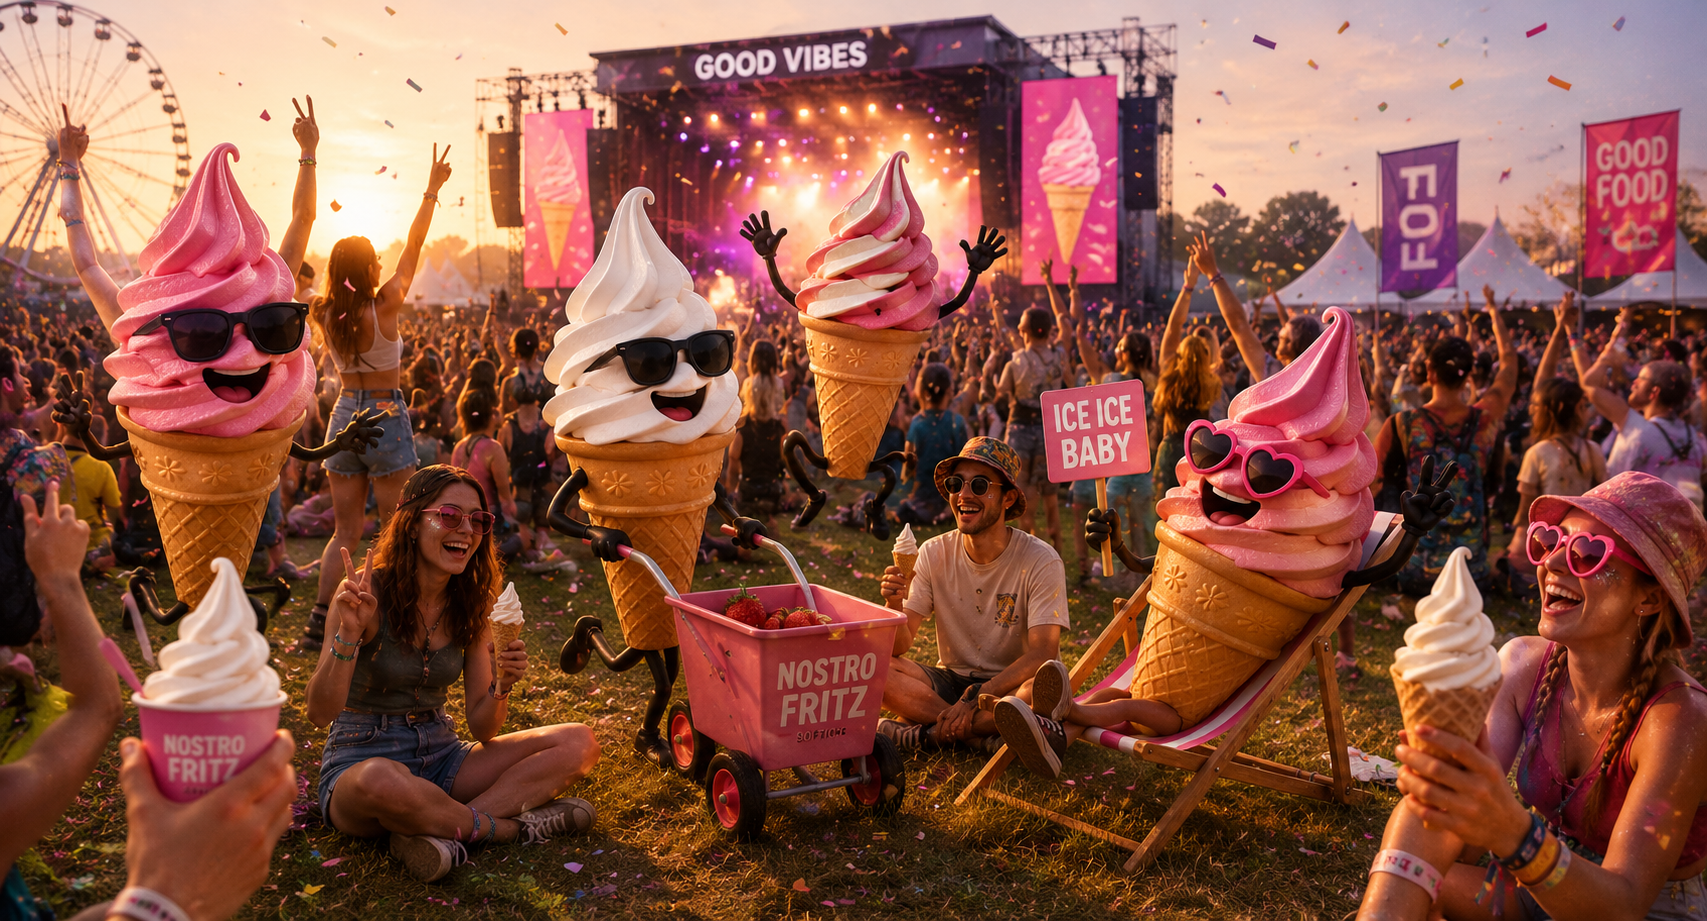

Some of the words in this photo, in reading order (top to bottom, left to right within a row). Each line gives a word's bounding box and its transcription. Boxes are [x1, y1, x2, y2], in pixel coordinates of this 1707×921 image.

[695, 49, 777, 81] GOOD
[782, 41, 868, 73] VIBES
[1596, 135, 1669, 172] GOOD
[1596, 168, 1669, 210] FOOD
[1053, 400, 1091, 433] ICE
[1096, 394, 1134, 428] ICE
[1061, 431, 1132, 469] BABY
[777, 652, 877, 691] NOSTRO
[780, 685, 869, 727] FRITZ
[163, 734, 246, 757] NOSTRO
[168, 757, 240, 784] FRITZ
